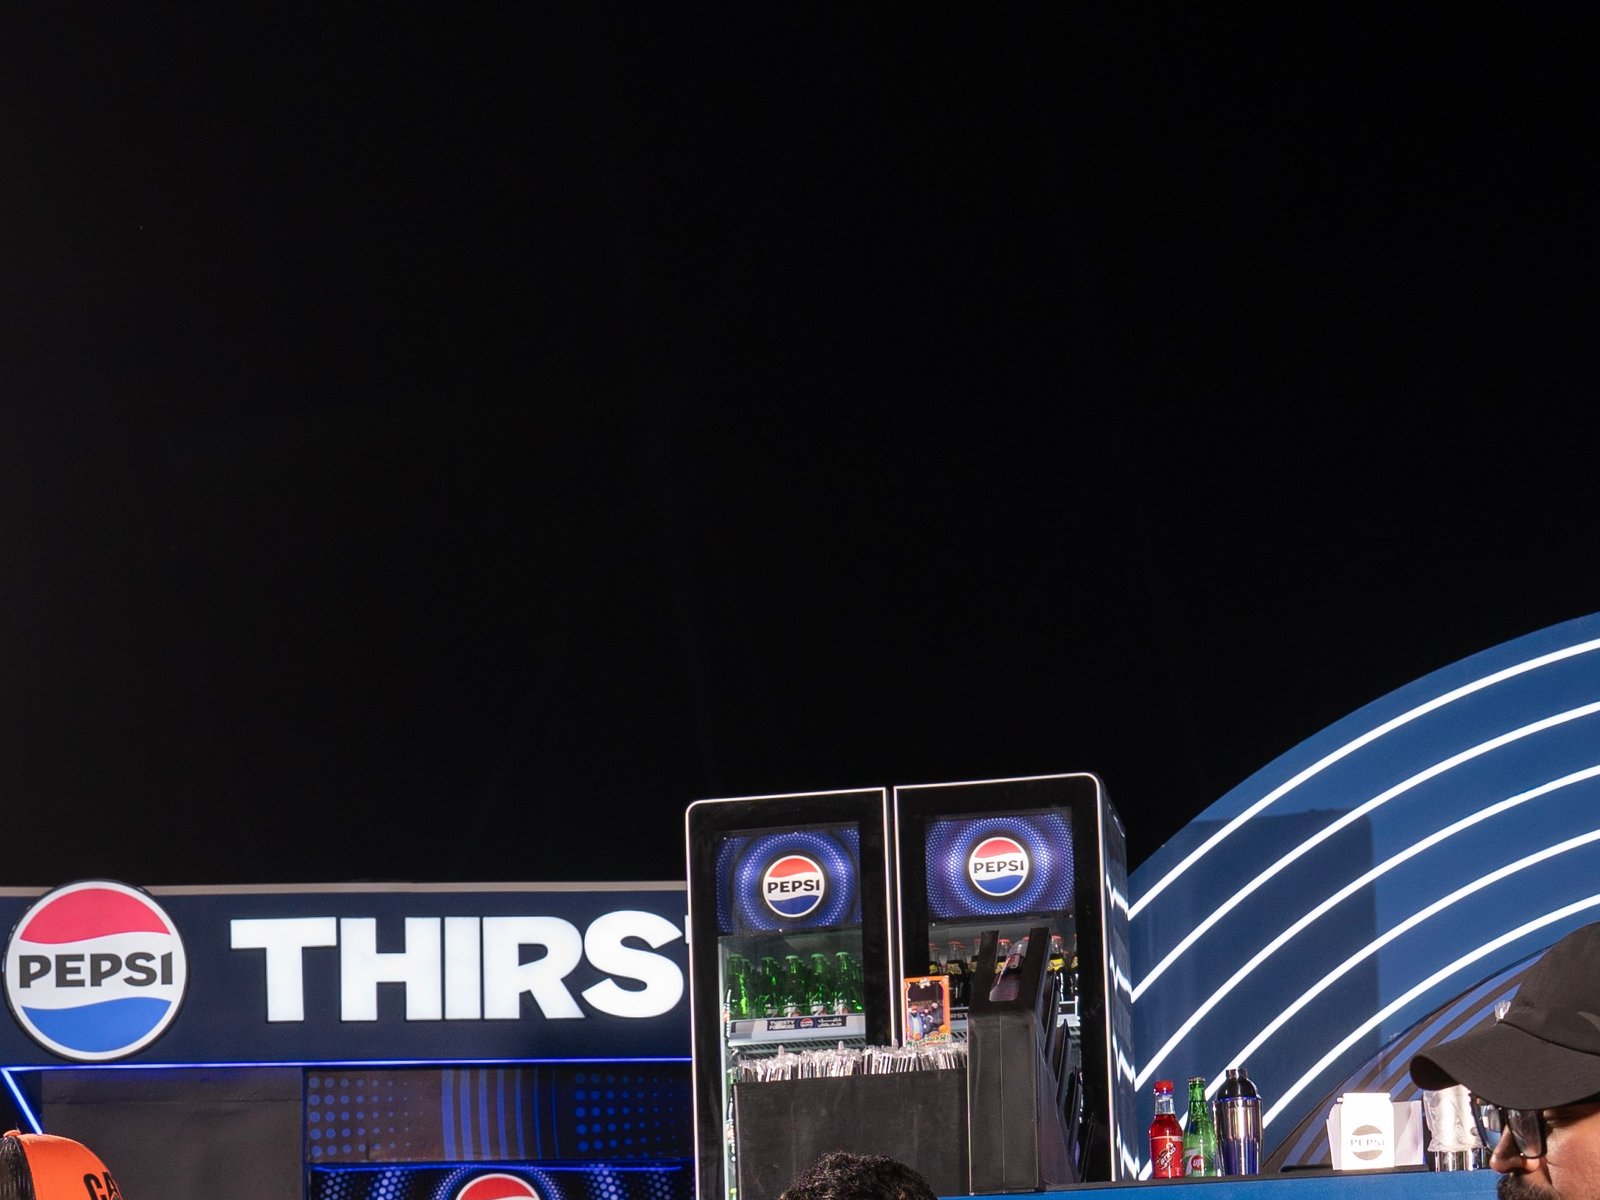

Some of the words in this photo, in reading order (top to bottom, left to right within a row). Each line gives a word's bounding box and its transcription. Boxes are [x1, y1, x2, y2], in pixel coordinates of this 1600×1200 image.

[974, 860, 1024, 873] PEPSI
[768, 879, 820, 893] PEPSI
[19, 951, 173, 988] PEPSI
[231, 910, 691, 1021] THIRS
